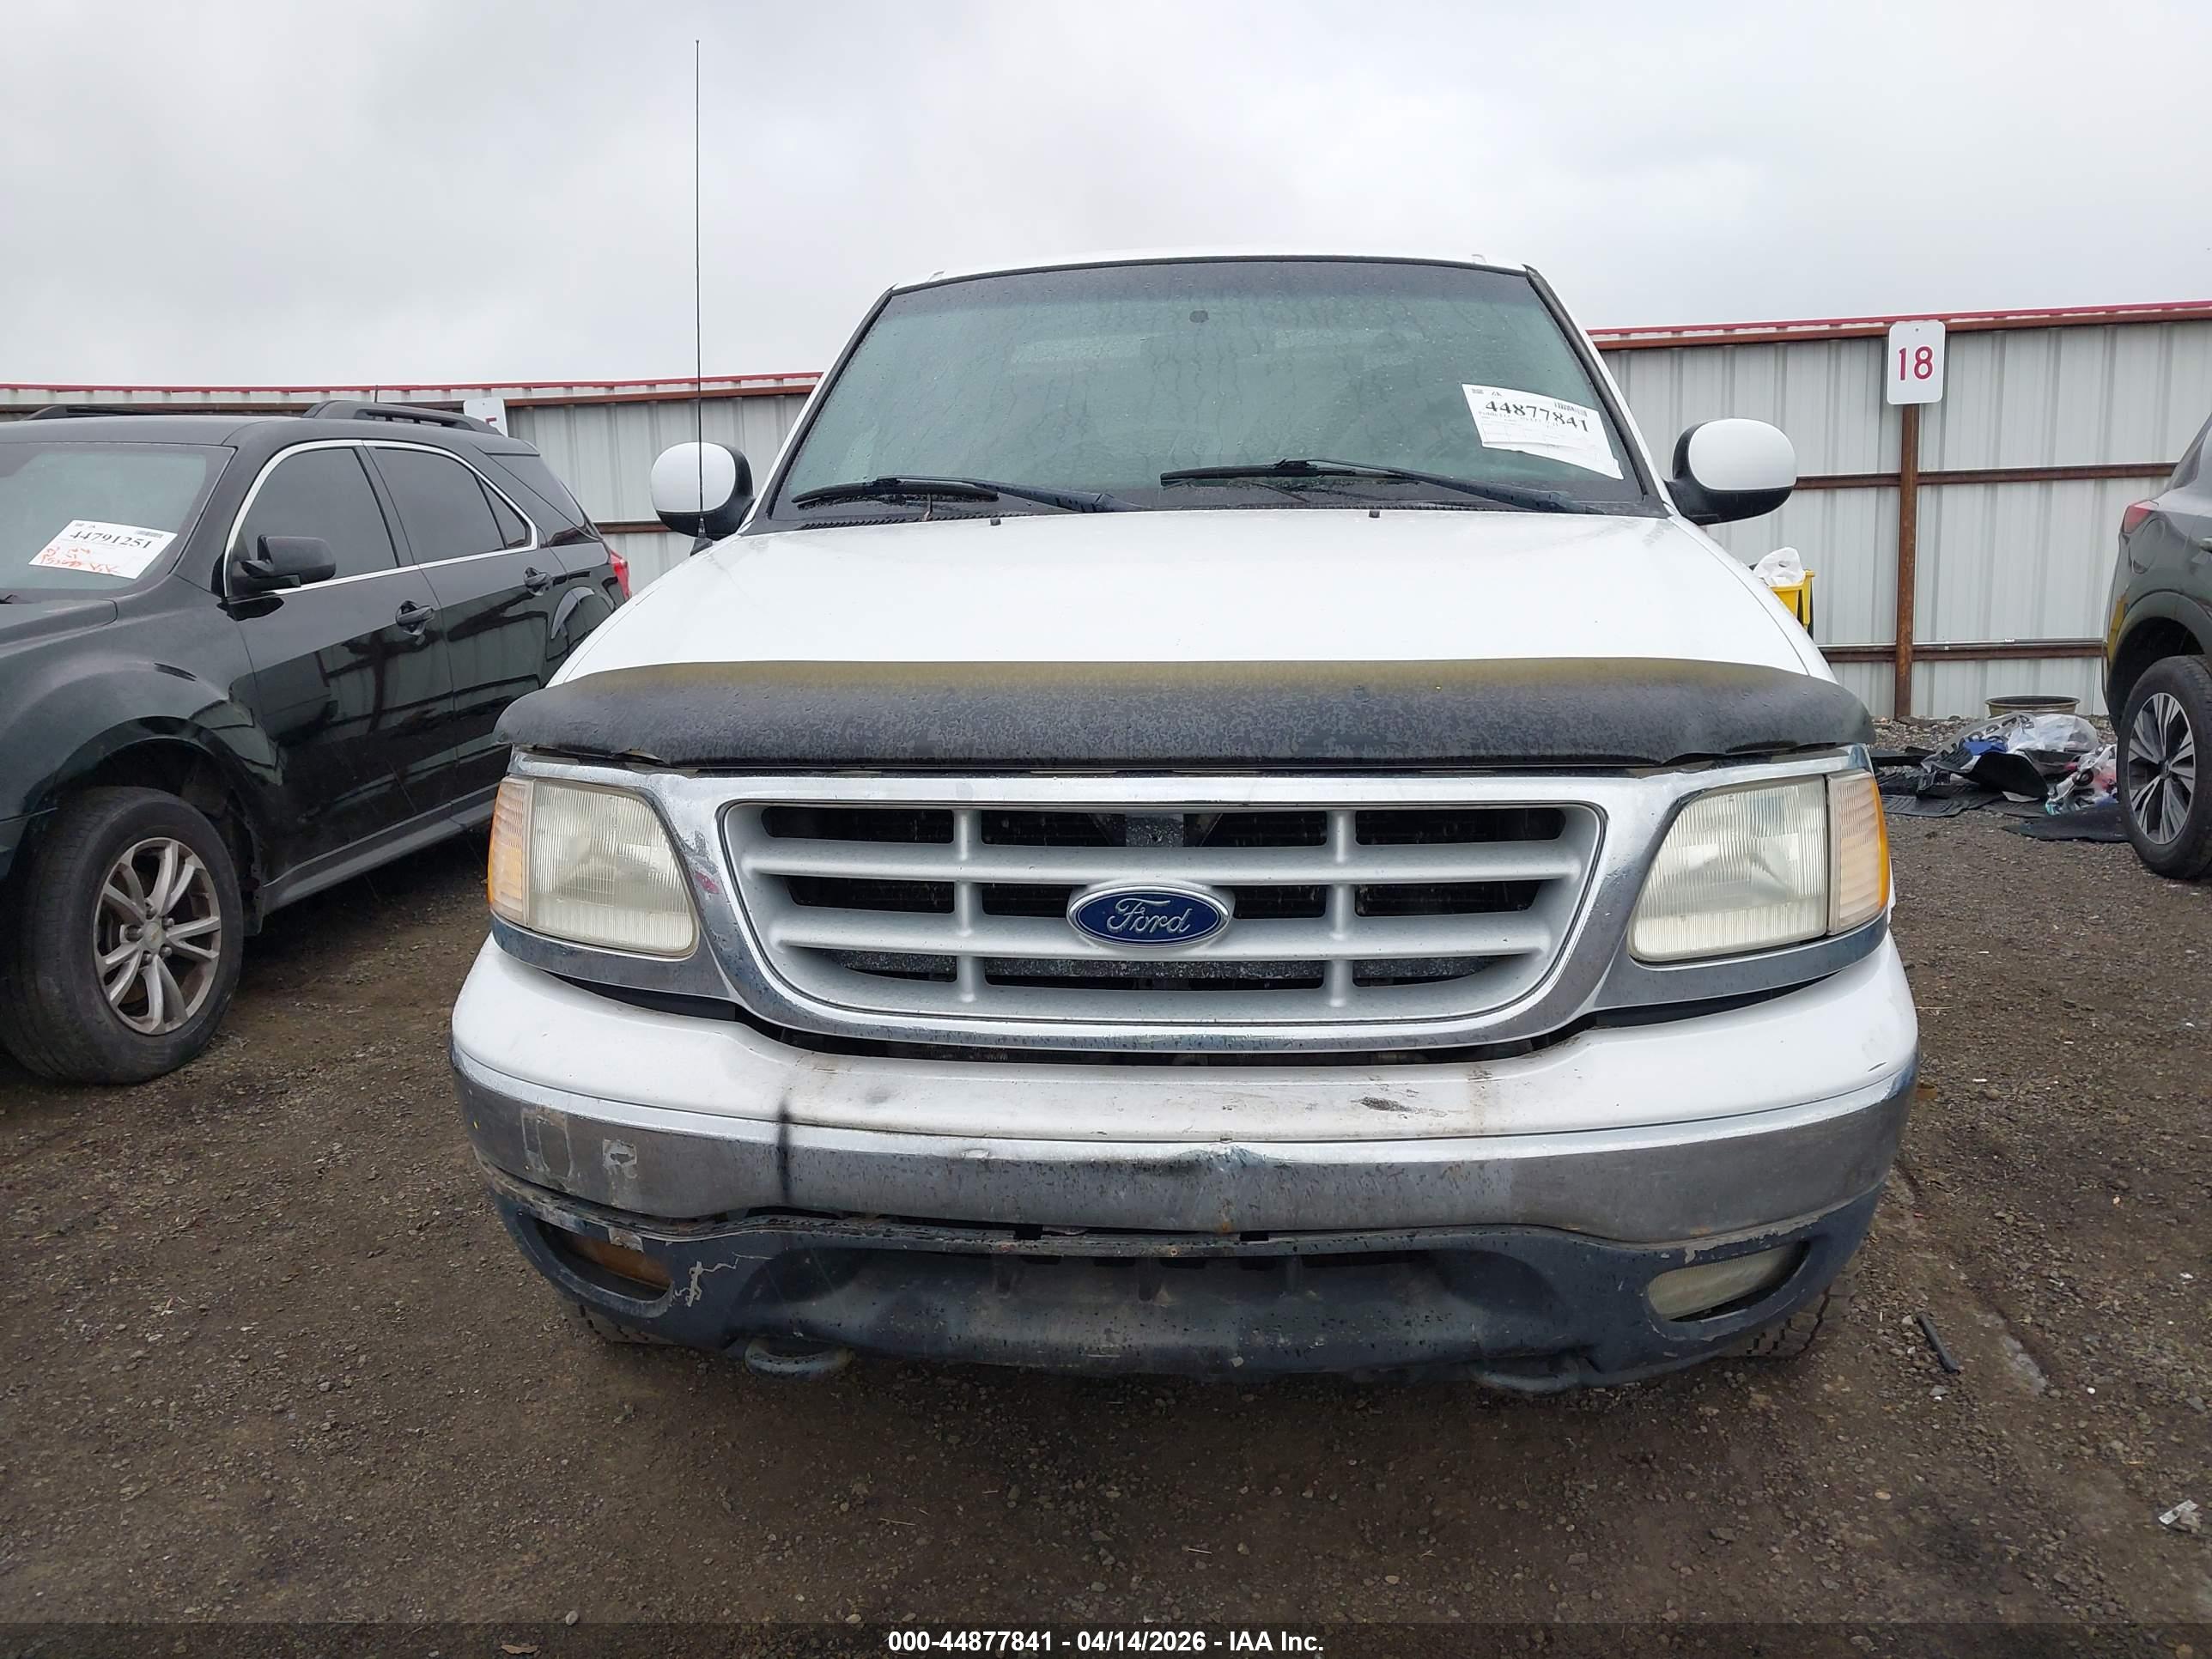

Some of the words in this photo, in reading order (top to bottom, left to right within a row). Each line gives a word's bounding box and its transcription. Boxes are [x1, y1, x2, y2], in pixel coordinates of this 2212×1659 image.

[1899, 345, 1934, 381] 18
[1486, 399, 1589, 432] 44877841
[70, 530, 153, 549] 44791251
[1106, 897, 1193, 933] Ford
